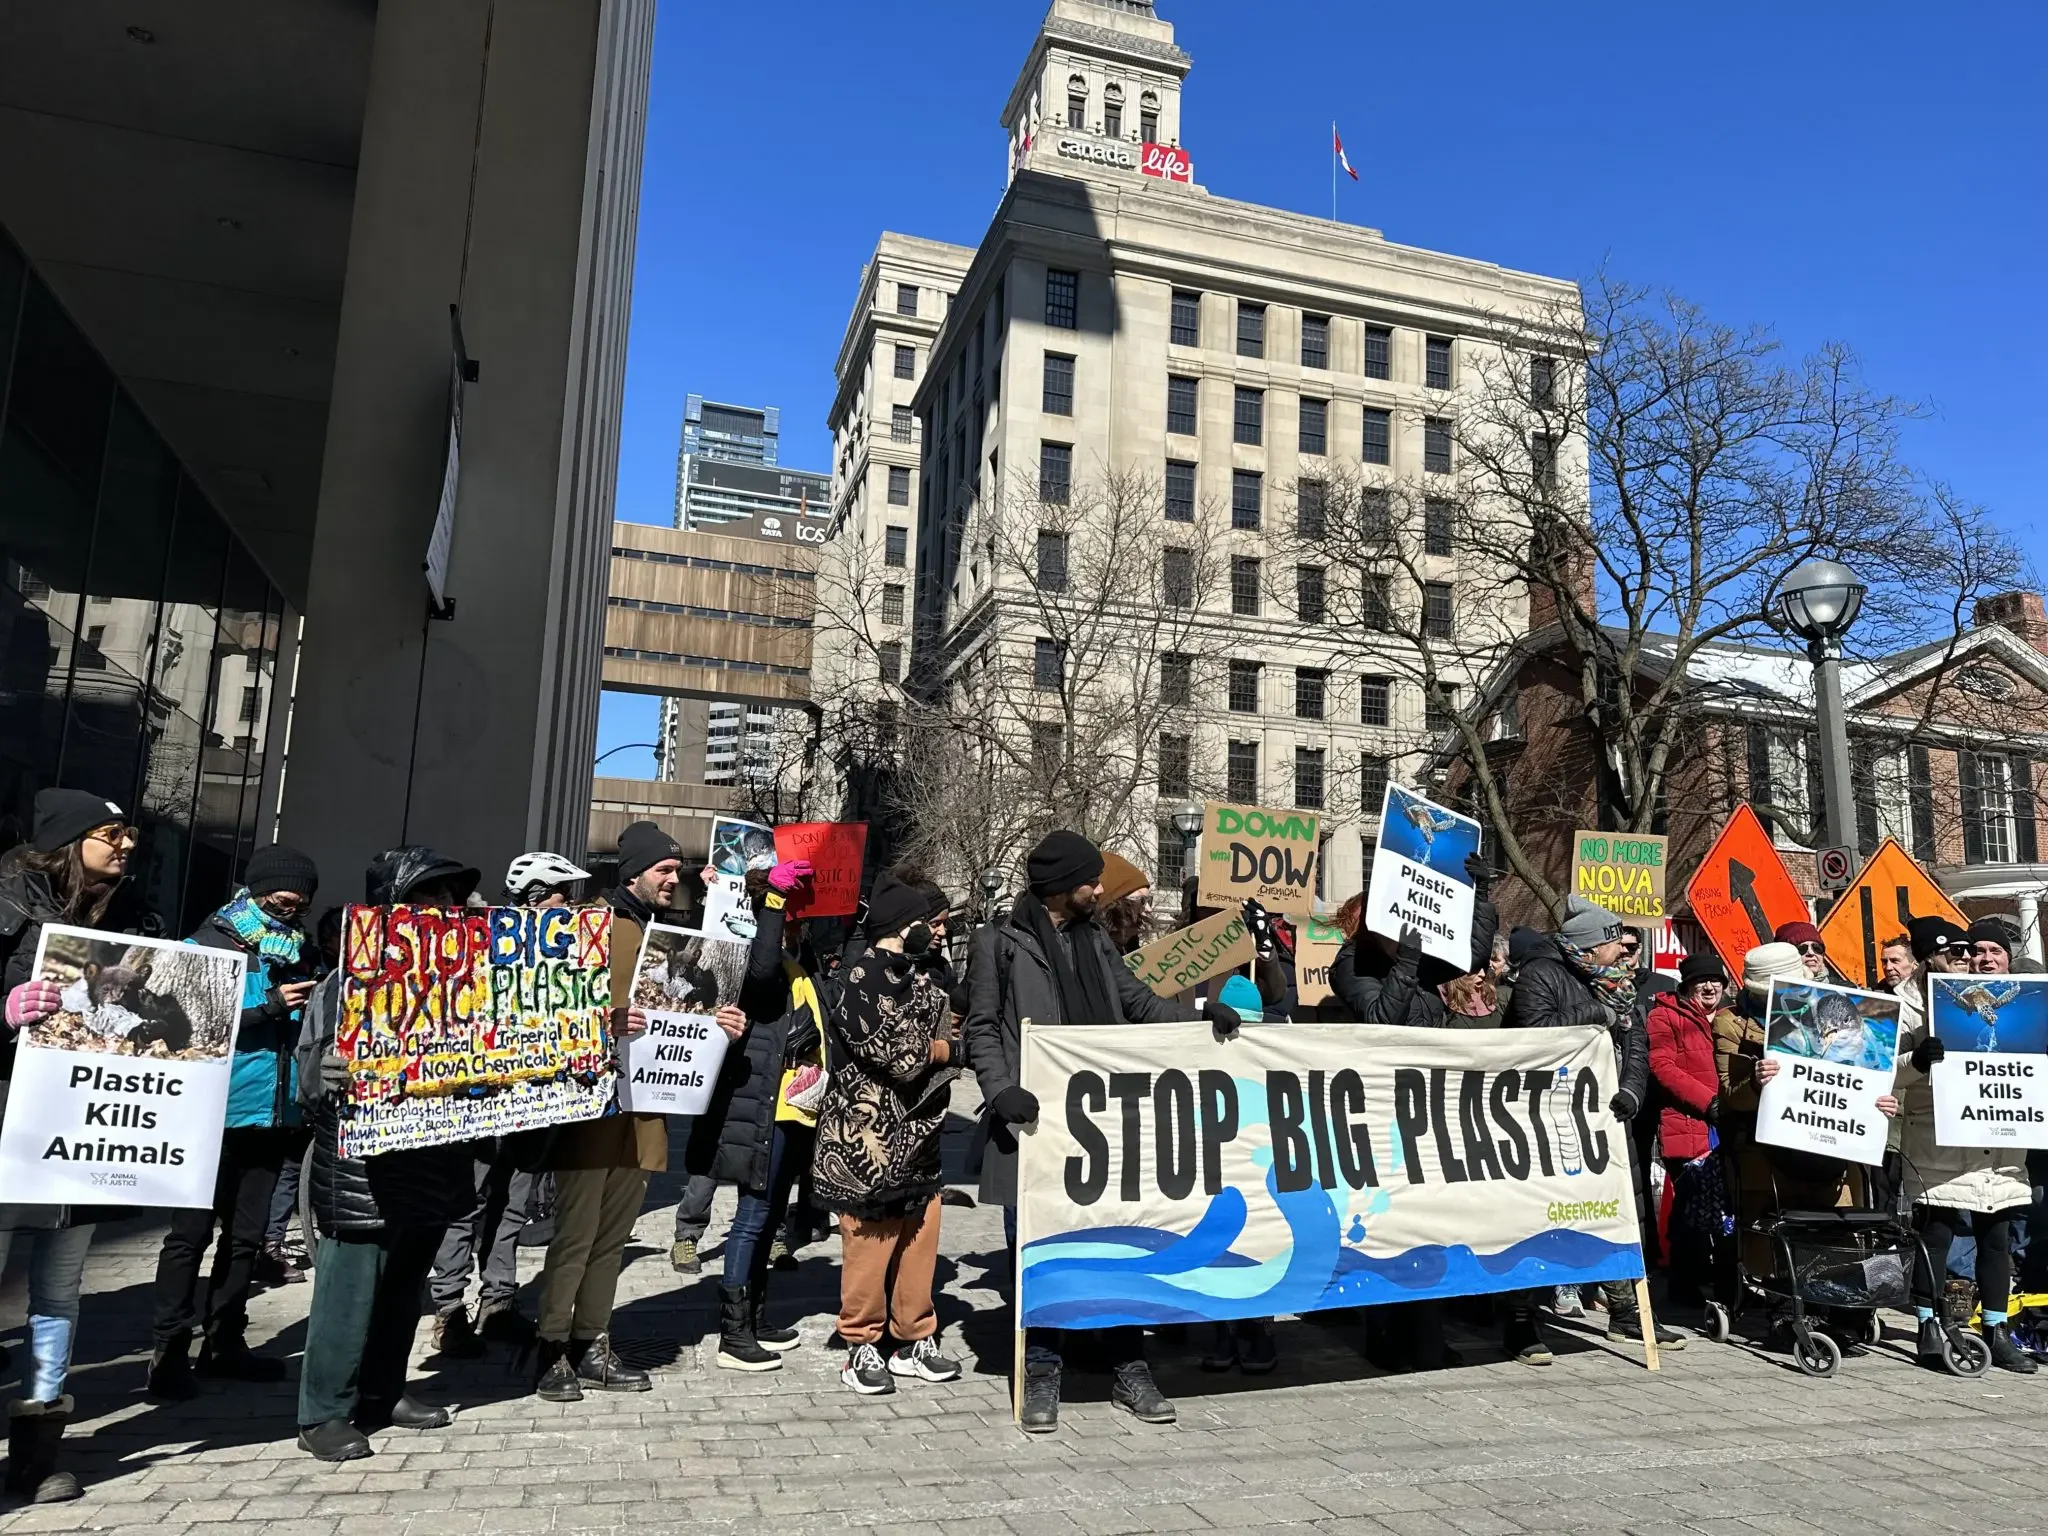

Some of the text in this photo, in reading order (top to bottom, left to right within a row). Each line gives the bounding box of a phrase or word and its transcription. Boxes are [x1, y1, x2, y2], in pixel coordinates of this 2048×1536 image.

[1142, 147, 1190, 180] life
[761, 528, 783, 538] TATA
[796, 521, 826, 543] tcs
[1216, 808, 1316, 842] DOWN
[1229, 842, 1315, 888] DOW
[1580, 838, 1663, 866] NO MORE
[1401, 864, 1454, 899] Plastic
[1578, 865, 1654, 895] NOVA
[1407, 888, 1442, 914] Kills
[1388, 902, 1455, 940] Animals
[385, 907, 576, 974] STOP BIG
[1174, 914, 1246, 988] POLLUTION
[1303, 966, 1330, 985] IMP
[406, 1029, 474, 1056] Chemical
[497, 1016, 591, 1051] Imperial Oil
[649, 1019, 709, 1040] Plastic
[471, 1053, 557, 1074] Chemicals
[655, 1044, 693, 1062] Kills
[69, 1065, 184, 1097] Plastic
[631, 1067, 704, 1087] Animals
[1792, 1063, 1864, 1091] Plastic
[1965, 1060, 2034, 1077] Plastic
[1803, 1088, 1848, 1110] Kills
[1979, 1083, 2023, 1099] Kills
[85, 1102, 158, 1130] Kills
[1780, 1106, 1866, 1137] Animals
[1960, 1105, 2045, 1123] Animals
[1063, 1067, 1610, 1206] STOP BIG PLASTIC
[41, 1136, 186, 1166] Animals
[109, 1179, 137, 1187] JUSTICE
[1547, 1198, 1620, 1224] GREENPEACE
